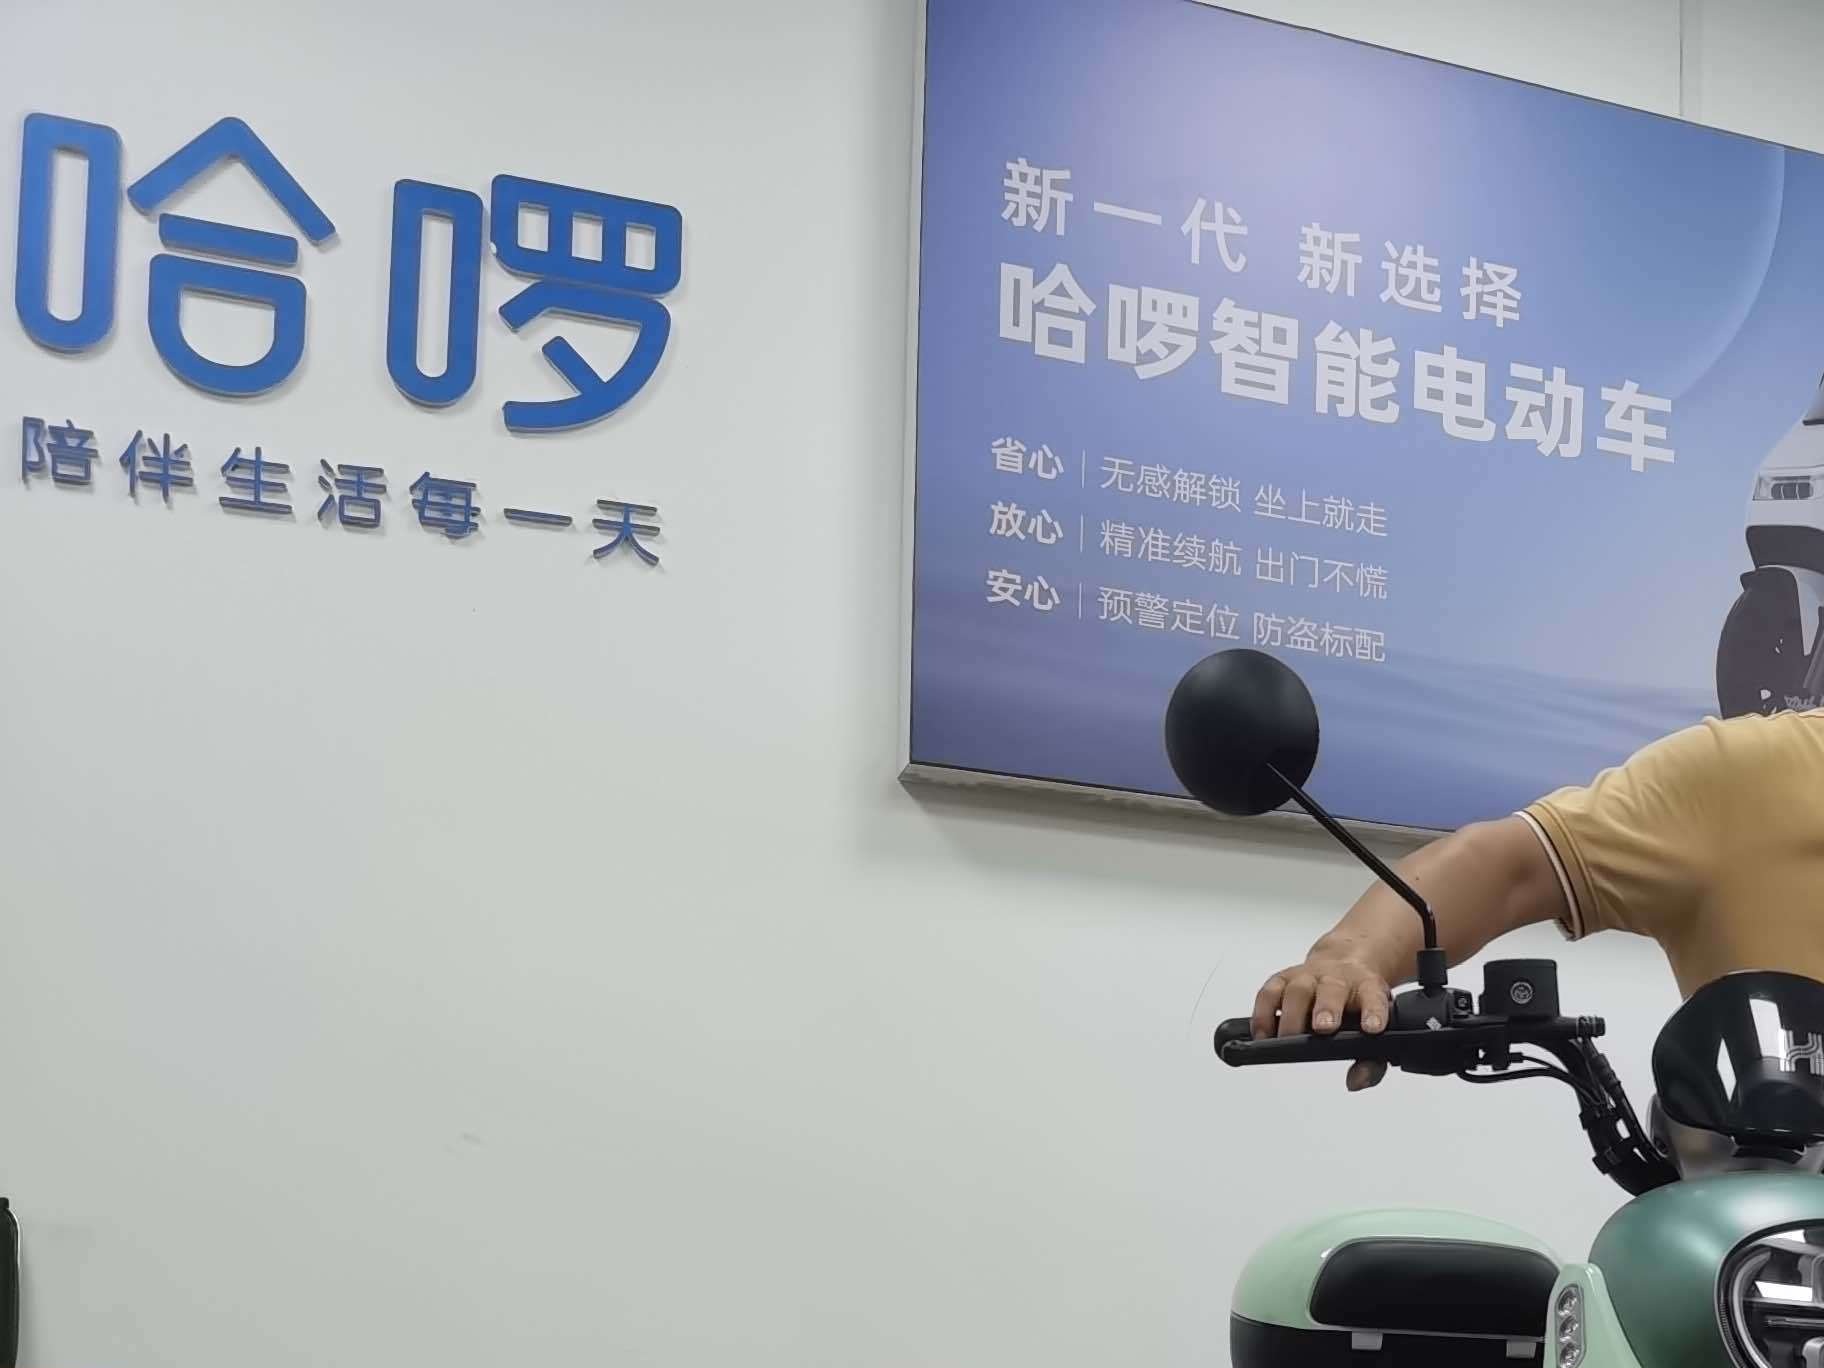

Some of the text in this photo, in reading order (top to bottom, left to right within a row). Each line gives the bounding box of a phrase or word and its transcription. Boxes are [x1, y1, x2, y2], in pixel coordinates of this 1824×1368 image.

[14, 112, 683, 434] 哈啰
[1001, 157, 1523, 328] 新一代 新选择
[998, 262, 1676, 473] 哈啰智能电动车
[21, 416, 661, 566] 陪伴生活每一天
[989, 501, 1389, 601] 放心 精准续航 出门不慌
[990, 436, 1389, 538] 省心 无感解锁 坐上就走
[986, 568, 1386, 663] 安心 预警定位 防盗标配
